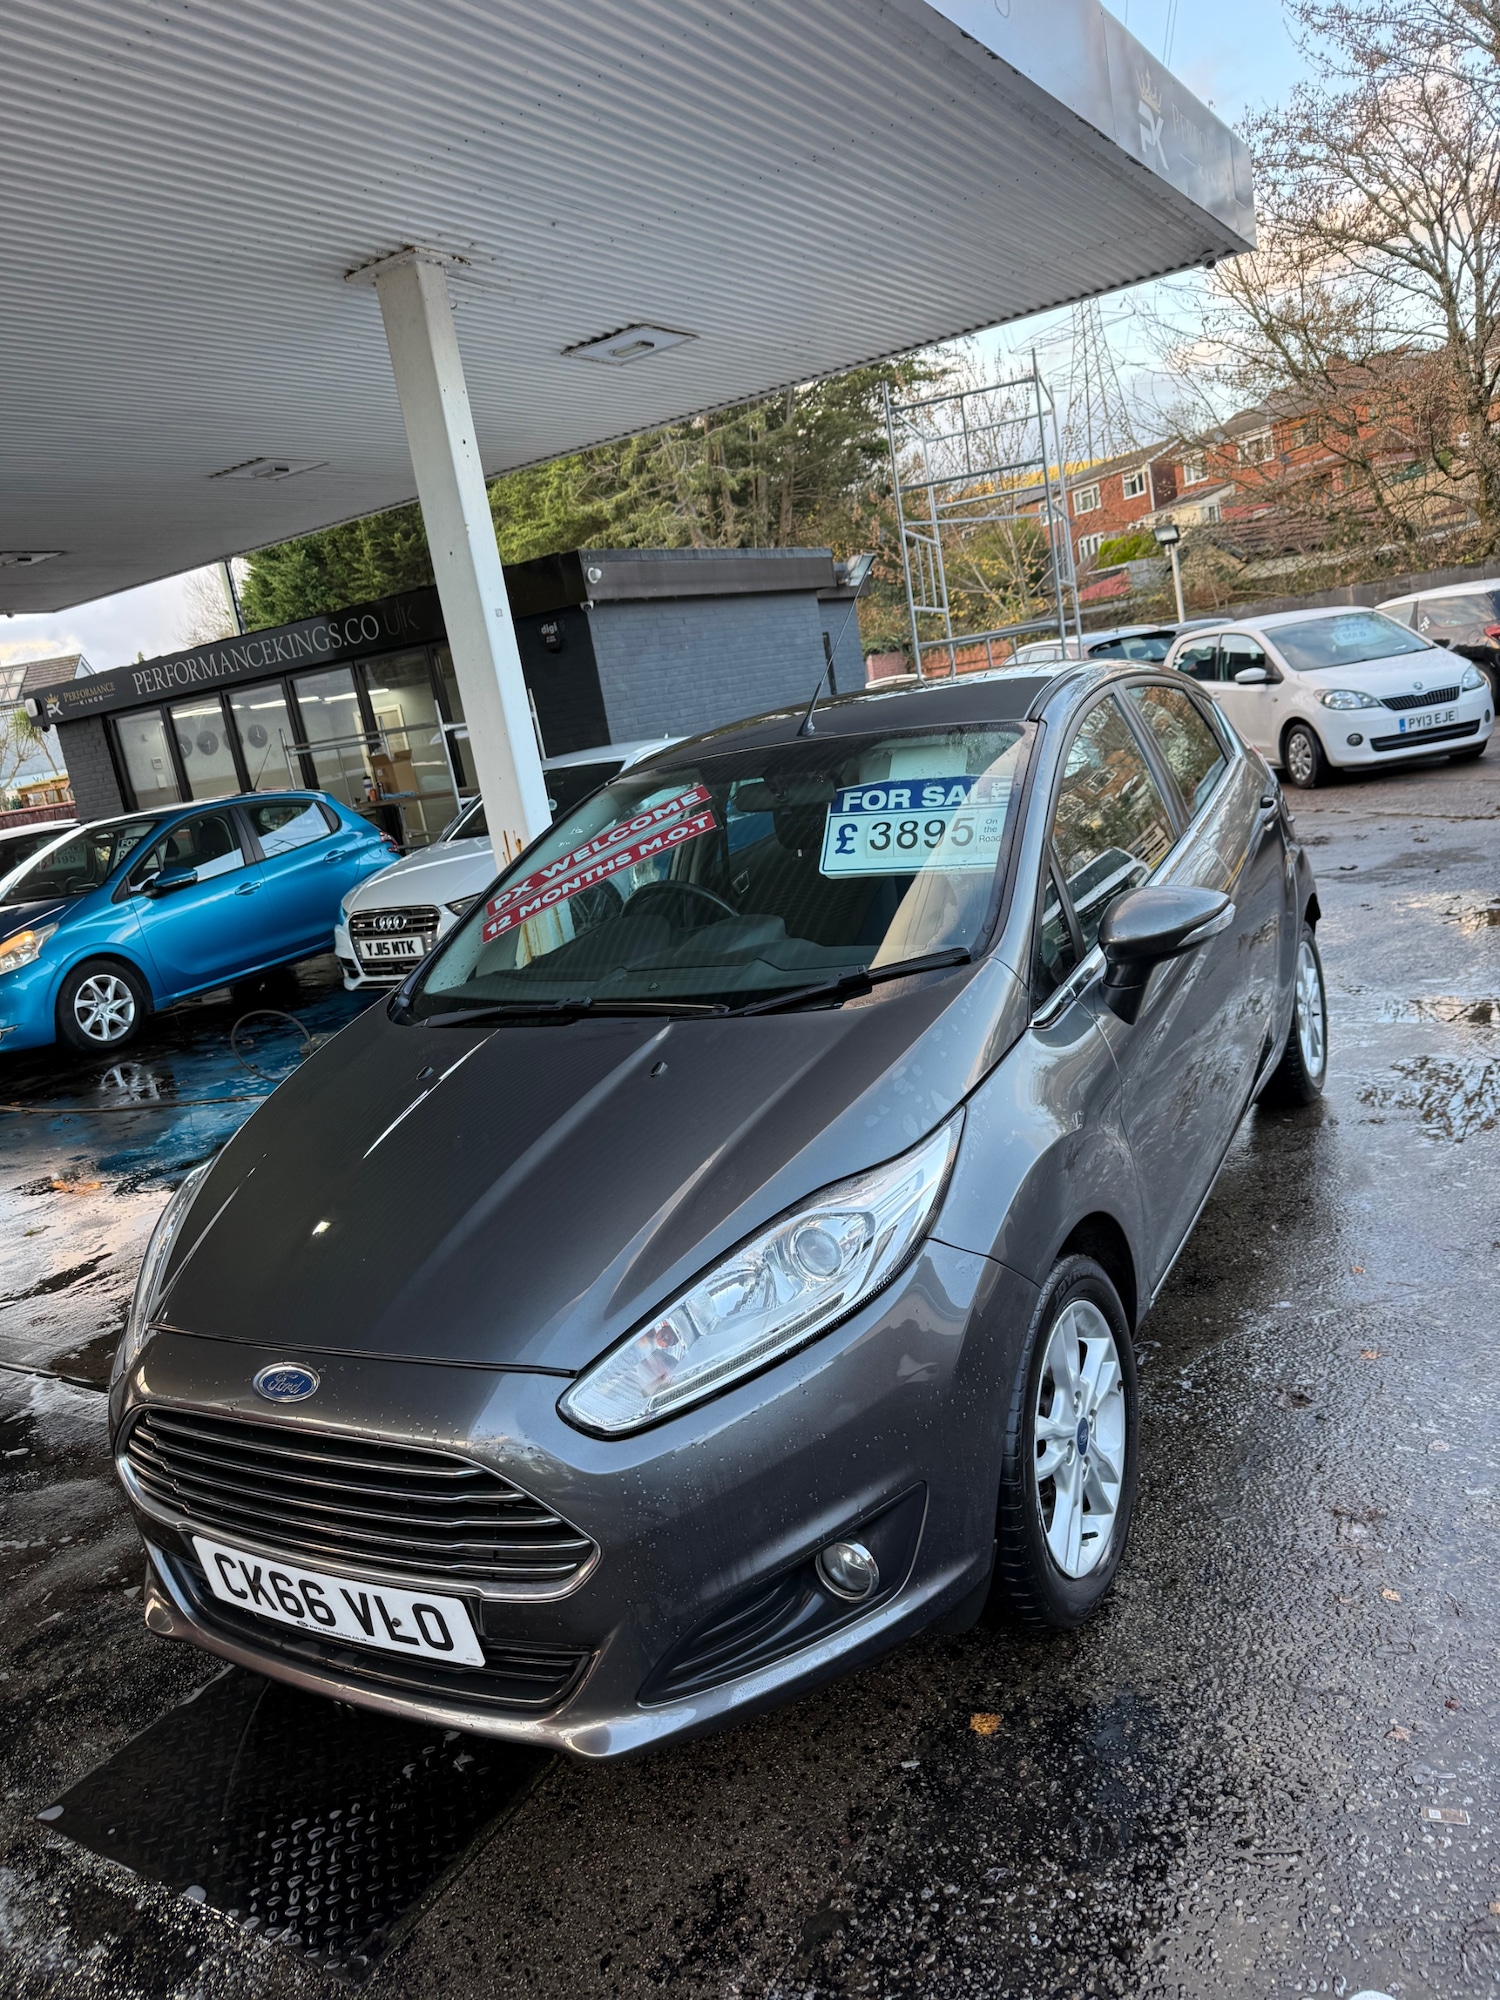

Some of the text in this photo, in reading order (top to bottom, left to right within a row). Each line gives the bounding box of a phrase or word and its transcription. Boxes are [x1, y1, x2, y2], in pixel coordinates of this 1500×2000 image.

[63, 681, 116, 703] PERFORMANCE
[79, 695, 104, 706] KINGS
[1408, 710, 1455, 729] PY13 EJE
[842, 782, 1012, 812] FOR SALE
[869, 817, 975, 851] 3895
[494, 791, 702, 910] PX WELCOME
[486, 815, 709, 936] 12 MONTHS M.O.T
[365, 942, 391, 957] YJ15
[267, 1371, 305, 1394] Ford
[214, 1552, 455, 1652] CK66 VLO
